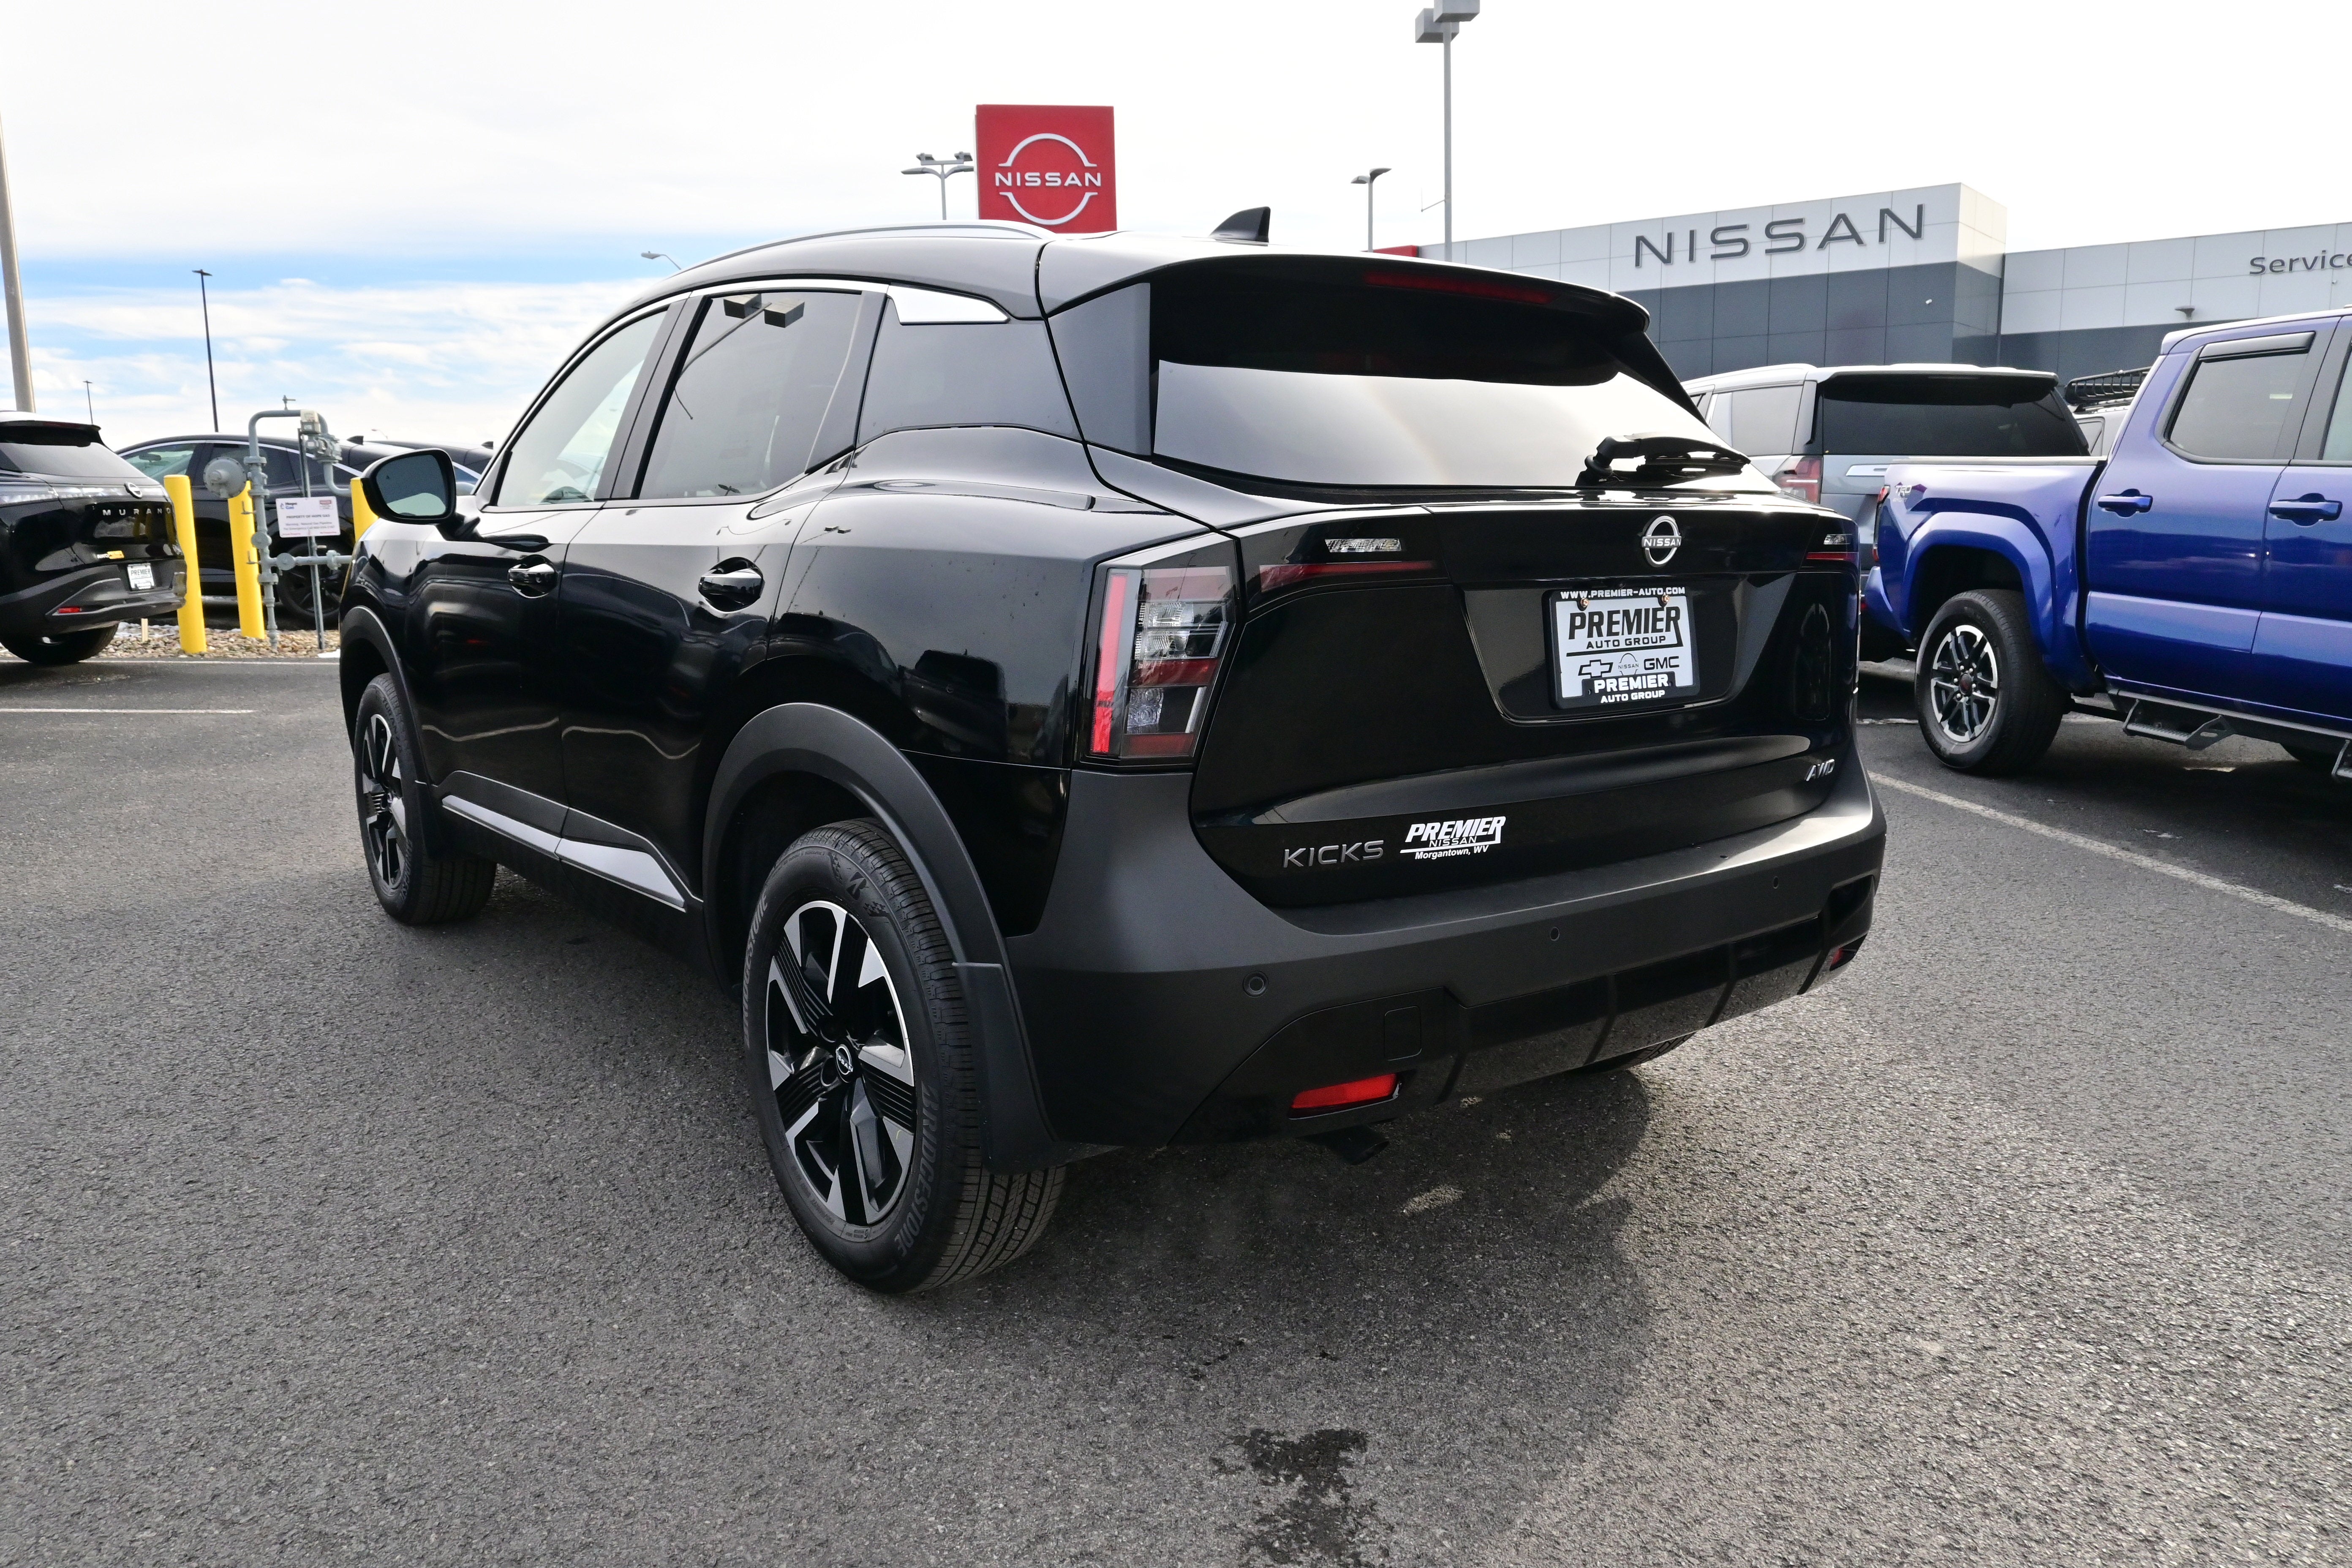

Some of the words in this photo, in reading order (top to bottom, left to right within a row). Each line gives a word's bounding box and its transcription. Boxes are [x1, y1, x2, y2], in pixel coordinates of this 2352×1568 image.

[995, 172, 1101, 186] NISSAN
[1635, 203, 1925, 268] NISSAN
[102, 508, 172, 516] MURANO
[1644, 538, 1681, 546] NISSAN
[1560, 587, 1685, 599] WWW.PREMIER-AUTO.COM
[1568, 606, 1683, 642] PREMIER
[1586, 638, 1620, 649] AUTO
[1625, 635, 1666, 646] GROUP
[1644, 656, 1680, 670] GMC
[1594, 674, 1669, 693] PREMIER
[1601, 694, 1629, 703] AUTO
[1631, 689, 1665, 700] GROUP
[1405, 816, 1506, 843] PREMIER
[1429, 836, 1477, 847] NISSAN
[1282, 840, 1384, 868] KICKS
[1415, 848, 1471, 860] Morgantown,
[1473, 845, 1489, 853] WV
[894, 1080, 940, 1258] BRIDGESTONE
